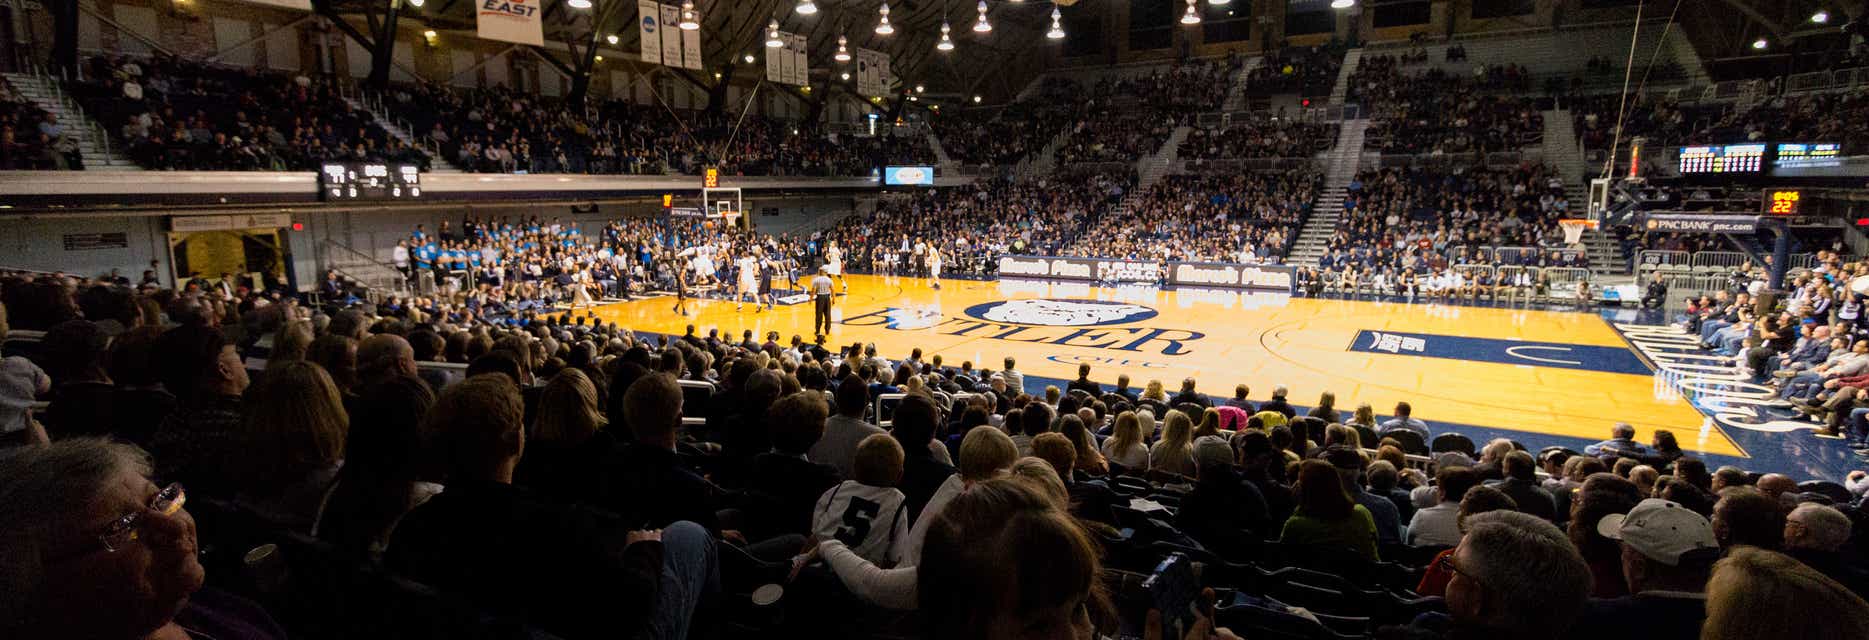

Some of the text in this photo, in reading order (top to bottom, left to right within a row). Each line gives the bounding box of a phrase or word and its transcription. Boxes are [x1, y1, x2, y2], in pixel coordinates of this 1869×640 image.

[483, 0, 537, 16] EAST
[1772, 201, 1792, 213] 22
[1713, 222, 1753, 232] pnc.com
[841, 306, 1205, 356] BUTLER
[834, 495, 881, 548] 5
